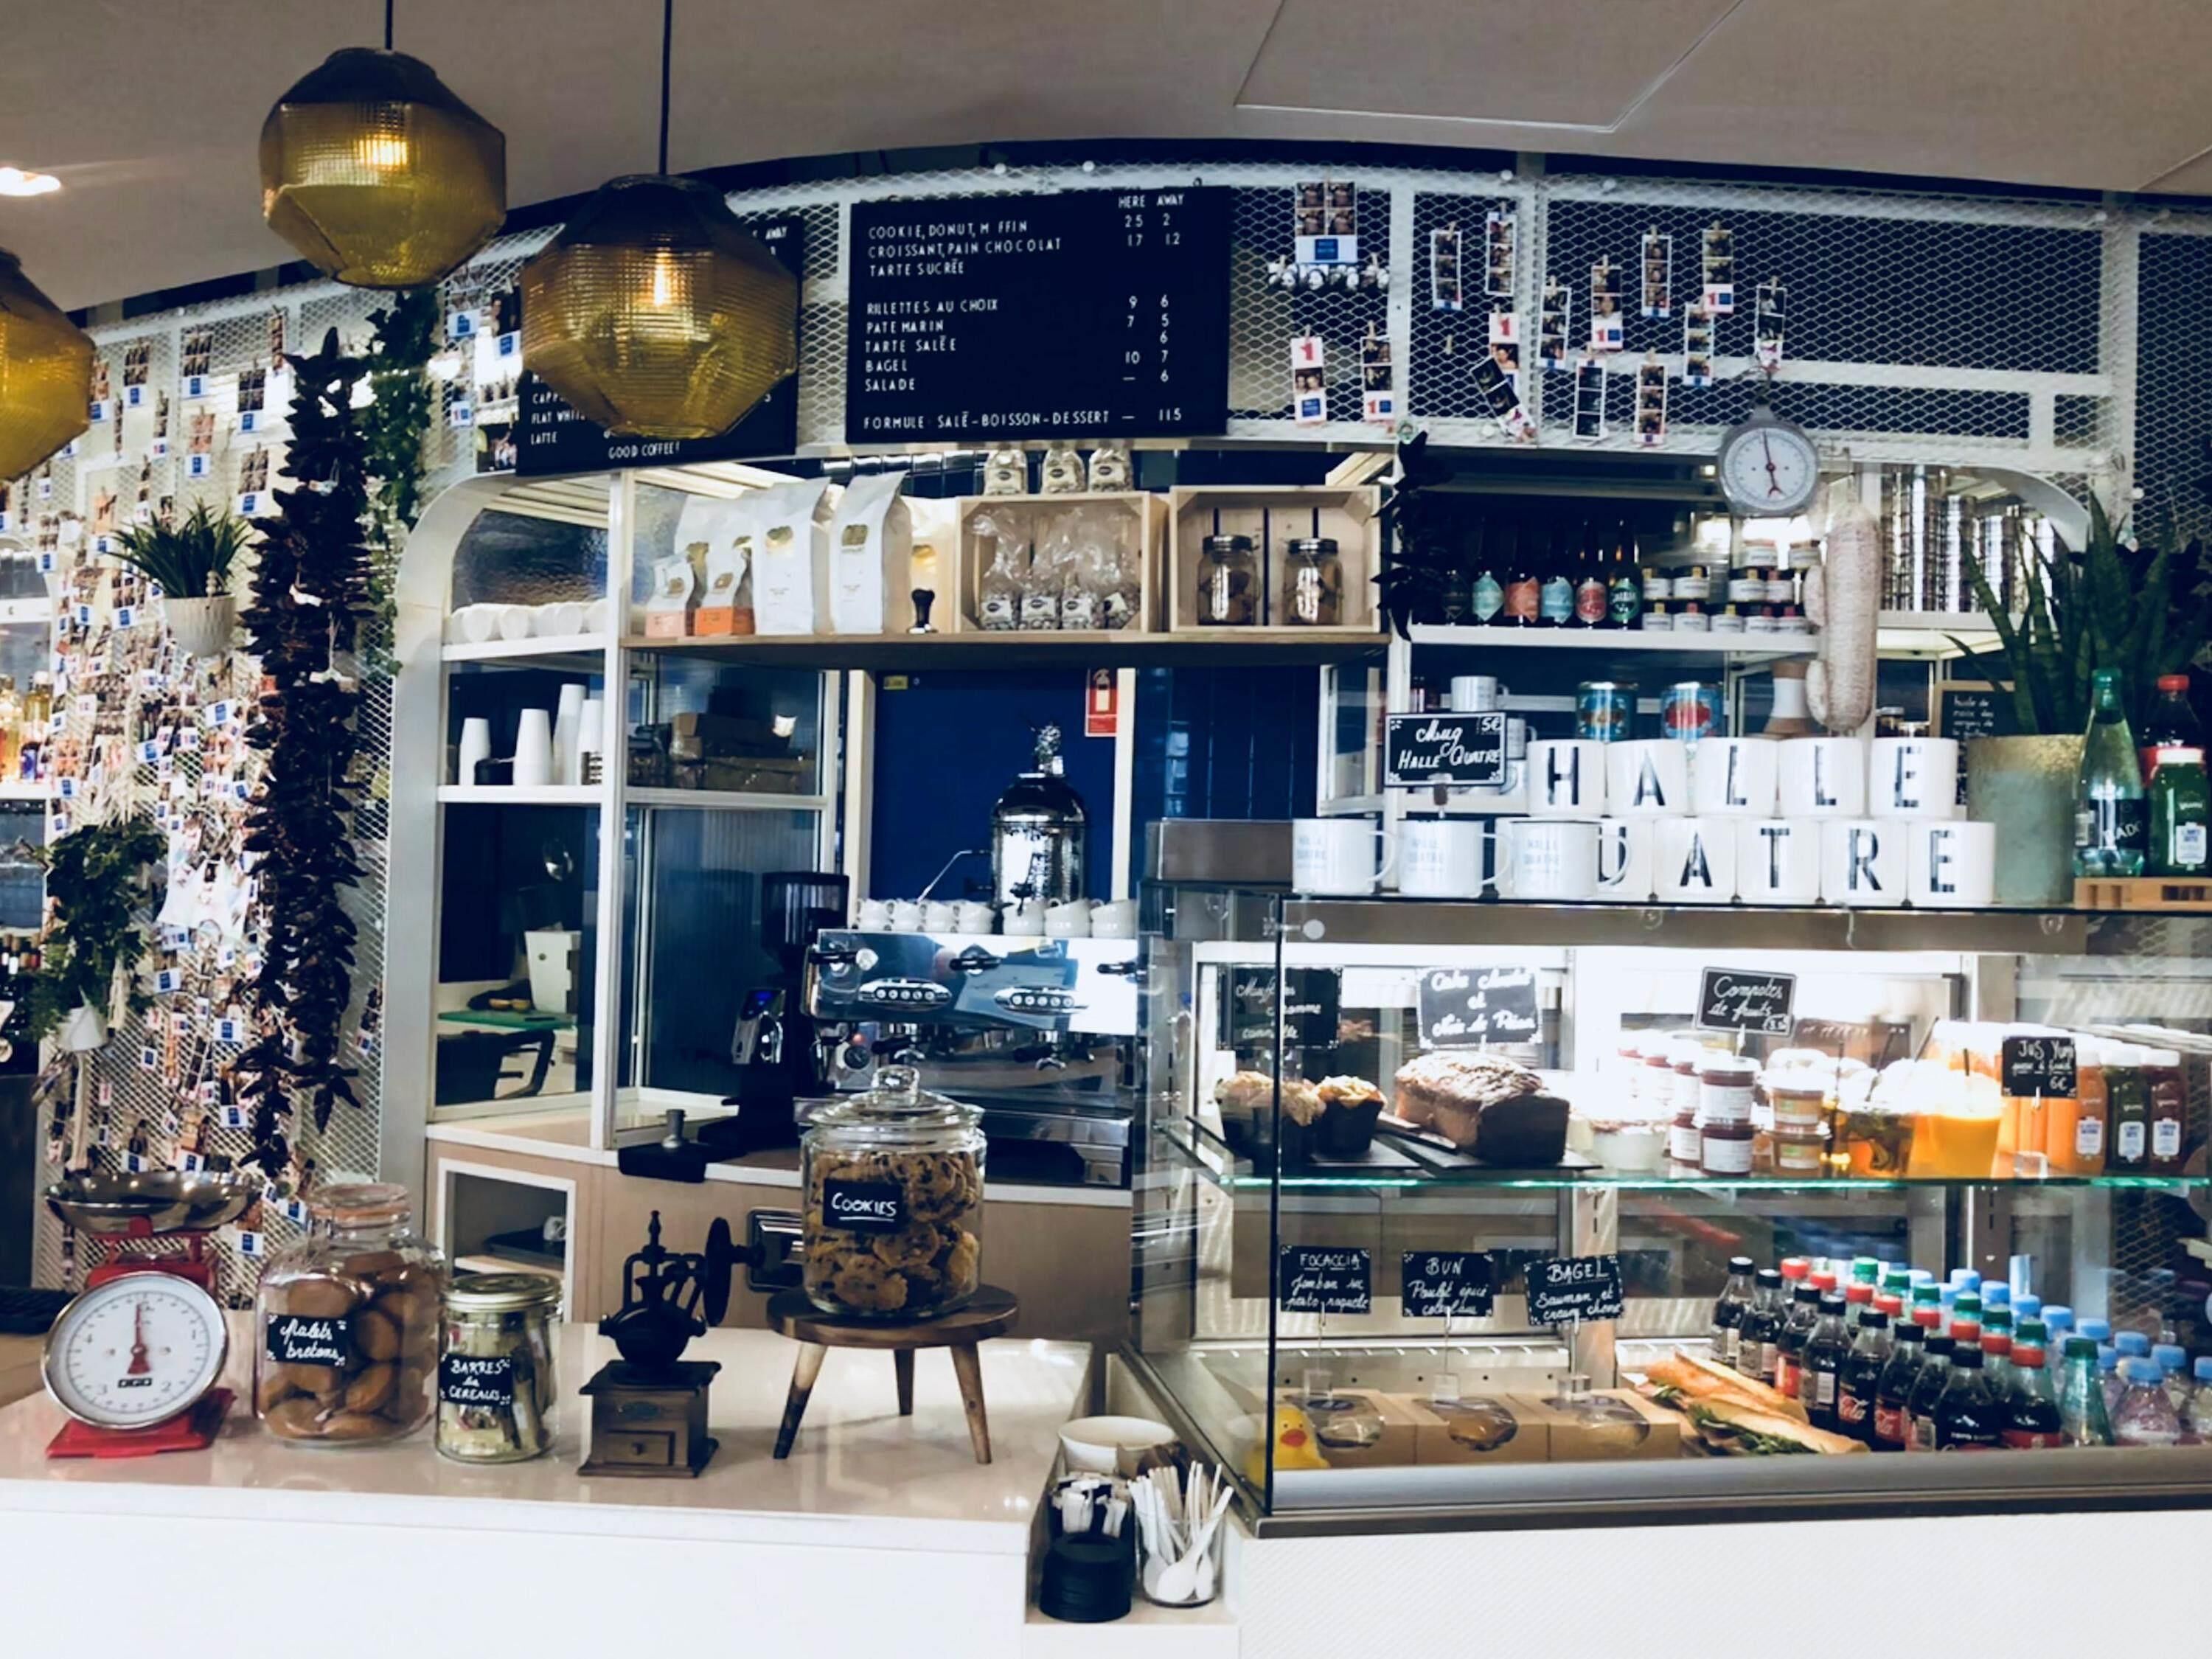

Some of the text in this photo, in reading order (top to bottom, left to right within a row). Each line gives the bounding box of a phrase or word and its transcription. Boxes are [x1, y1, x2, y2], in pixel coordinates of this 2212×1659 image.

[1118, 193, 1185, 209] HERE AWAY
[1162, 212, 1171, 226] 2
[947, 242, 979, 255] PAIN
[985, 237, 1061, 254] CHOCOLAT
[869, 263, 911, 277] TARTE
[866, 298, 999, 316] RILLETTES AU CHOIX
[1129, 294, 1169, 309] 9 6
[866, 319, 944, 334] PATE MARIN
[1127, 313, 1169, 327] 7 5
[1159, 330, 1168, 344] 6
[865, 339, 906, 353] TARTE
[1124, 349, 1169, 364] 10 7
[865, 359, 908, 373] BAGEL
[1160, 369, 1169, 383] 6
[865, 378, 916, 392] SALADE
[531, 411, 552, 425] FLAT
[863, 415, 925, 430] FORMULE
[530, 431, 558, 445] LATTE
[608, 444, 639, 460] GOOD
[1481, 717, 1501, 732] 5€
[1299, 1253, 1361, 1270] FOCACCIA
[1425, 1256, 1466, 1276] BUN
[1546, 1259, 1609, 1284] BAGEL
